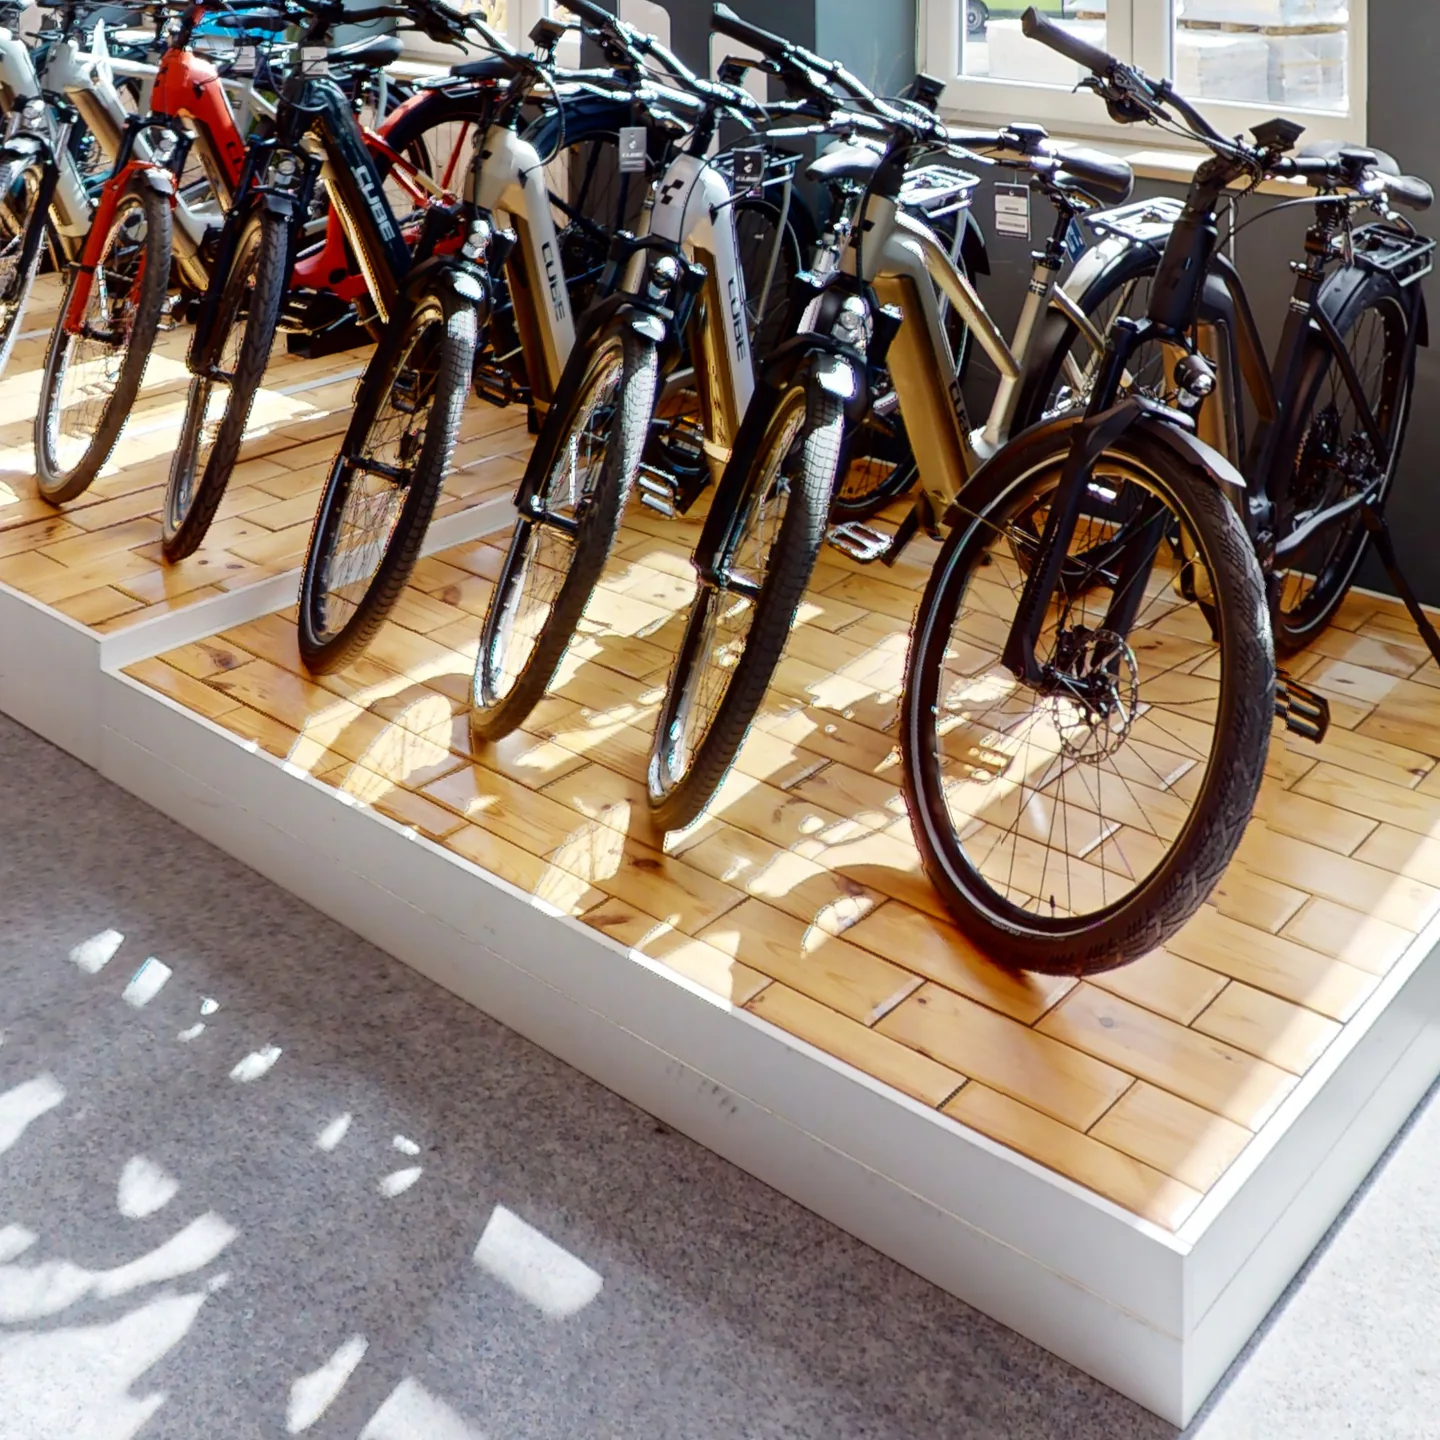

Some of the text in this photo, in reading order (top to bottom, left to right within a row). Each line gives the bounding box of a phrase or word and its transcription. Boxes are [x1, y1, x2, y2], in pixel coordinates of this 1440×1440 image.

[351, 165, 395, 242] CUBE
[541, 241, 565, 322] CUBE
[728, 277, 747, 362] CUBE
